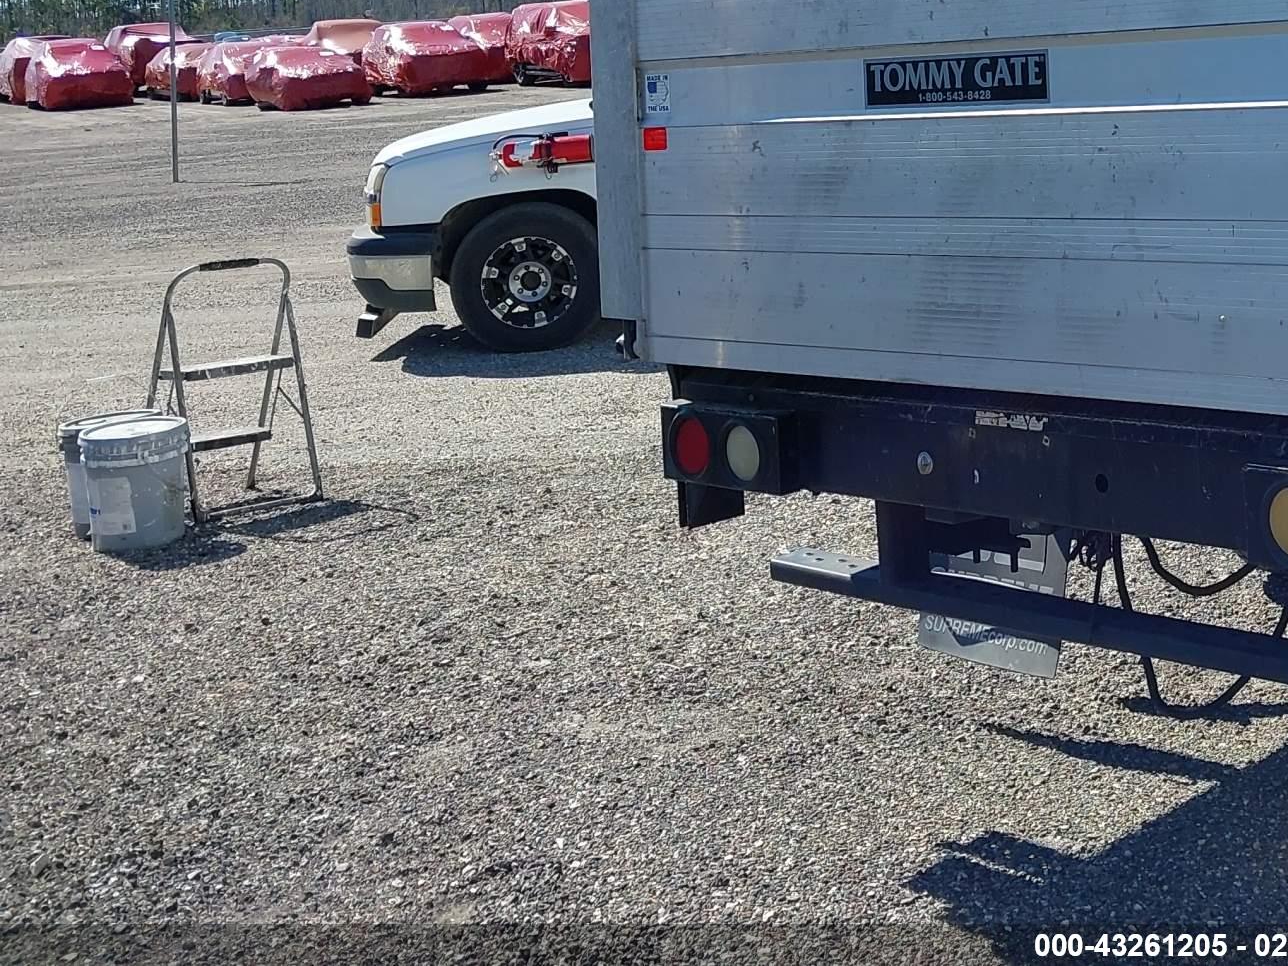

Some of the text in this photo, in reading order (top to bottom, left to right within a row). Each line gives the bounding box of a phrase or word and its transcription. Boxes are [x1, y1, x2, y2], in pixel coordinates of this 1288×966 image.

[870, 56, 1043, 91] TOMMY GATE
[918, 89, 992, 103] 1-800-543-8428
[924, 614, 1049, 656] SUPREMEcorp.com
